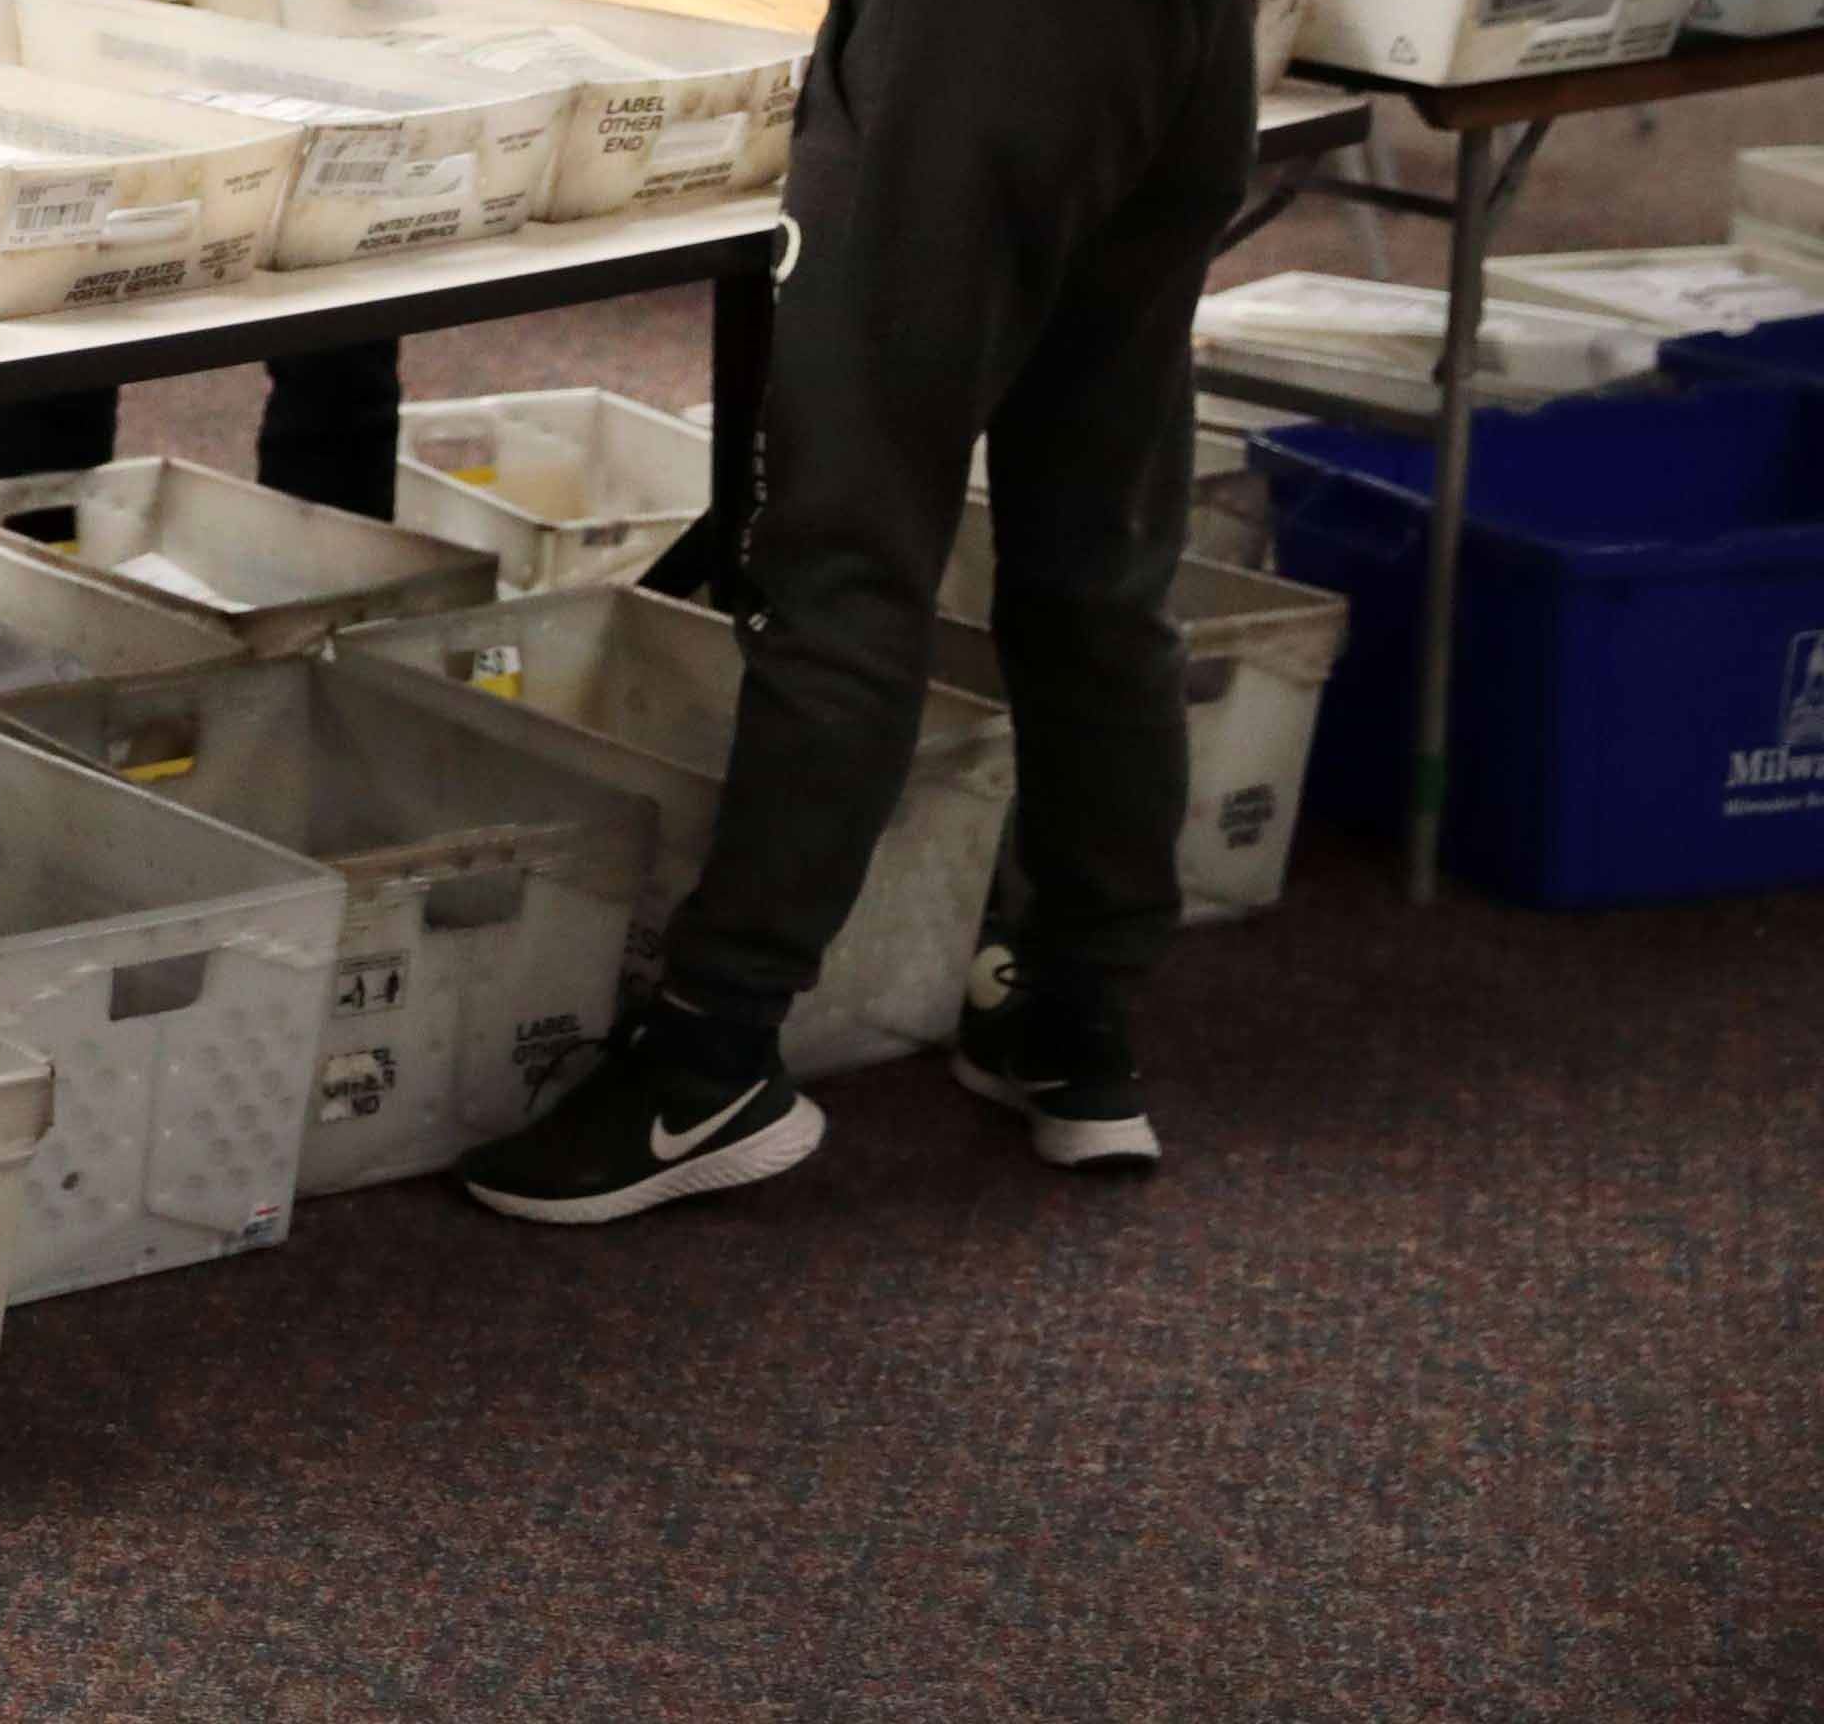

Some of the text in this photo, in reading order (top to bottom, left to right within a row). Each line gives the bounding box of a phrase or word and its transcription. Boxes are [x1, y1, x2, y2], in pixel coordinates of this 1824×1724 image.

[605, 96, 665, 115] LABEL
[598, 114, 664, 135] OTHER
[603, 135, 644, 154] END
